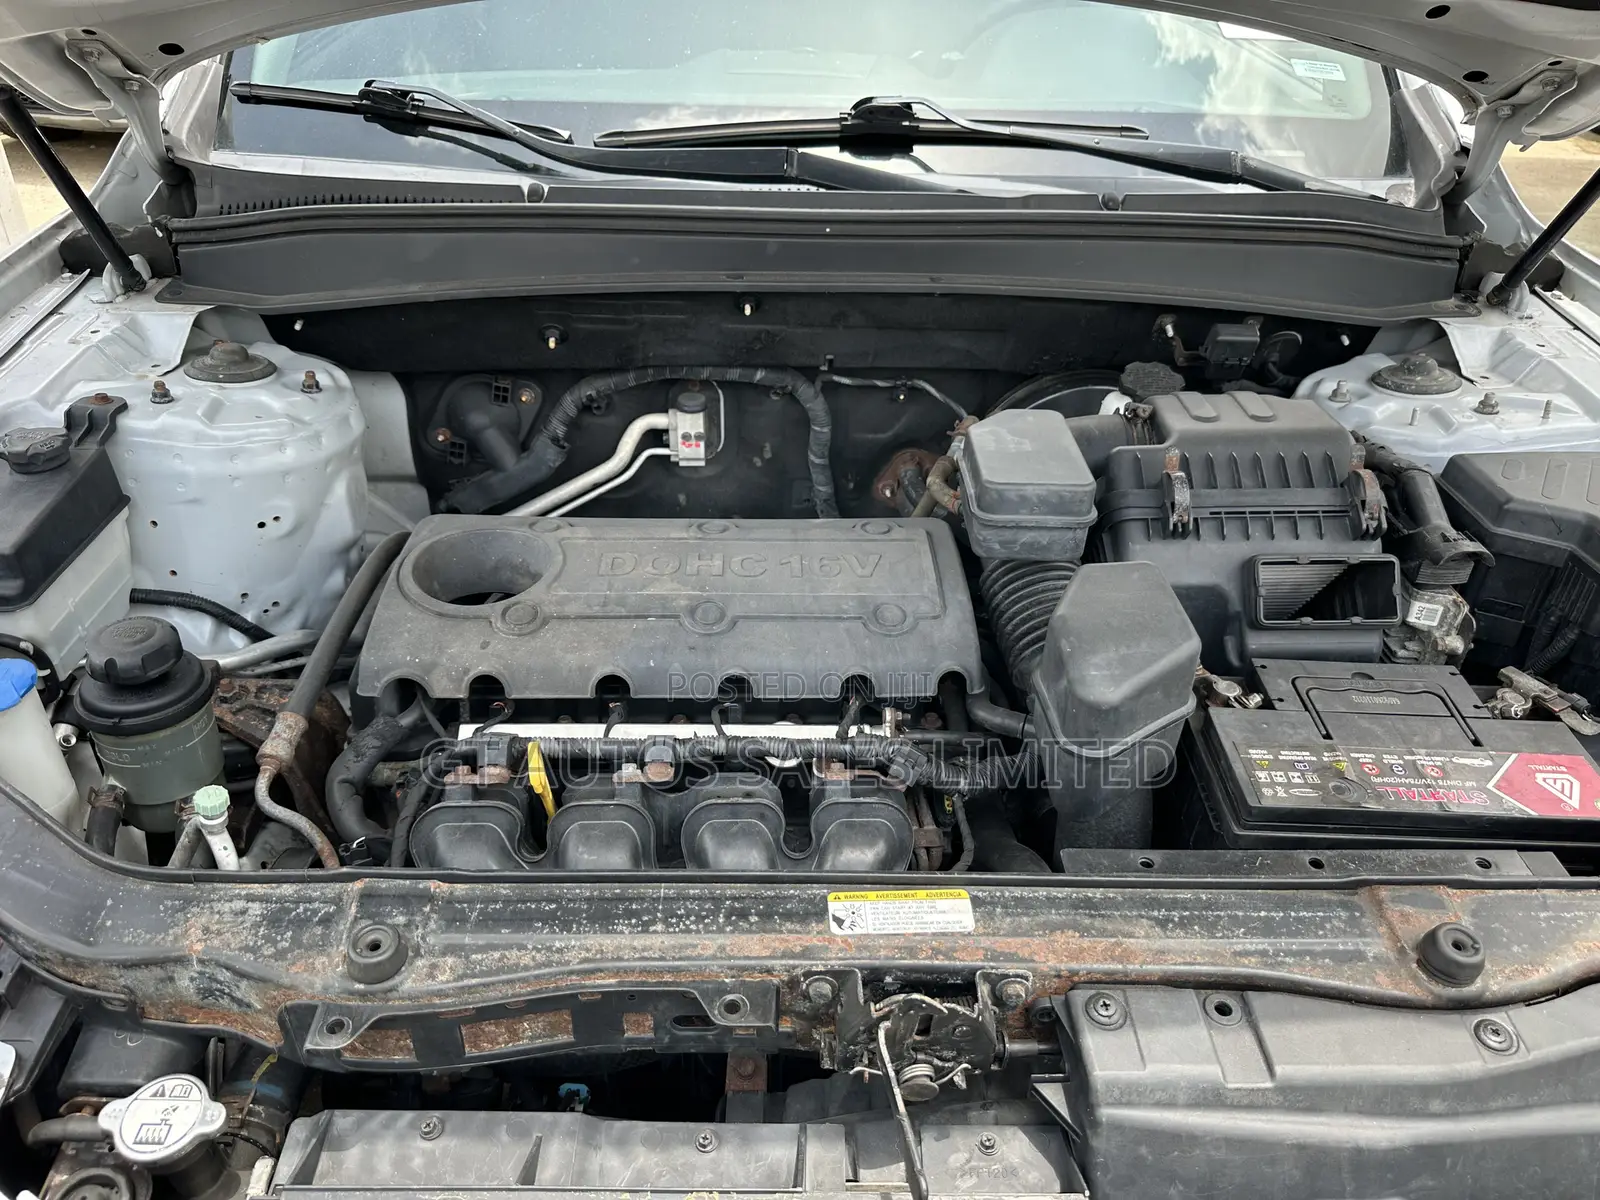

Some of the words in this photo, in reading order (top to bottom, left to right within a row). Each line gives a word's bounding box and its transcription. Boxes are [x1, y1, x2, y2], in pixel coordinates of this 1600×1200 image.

[598, 552, 768, 578] DOHC
[778, 552, 883, 579] 16V
[1414, 605, 1426, 621] A342
[1375, 785, 1490, 805] STARTALL
